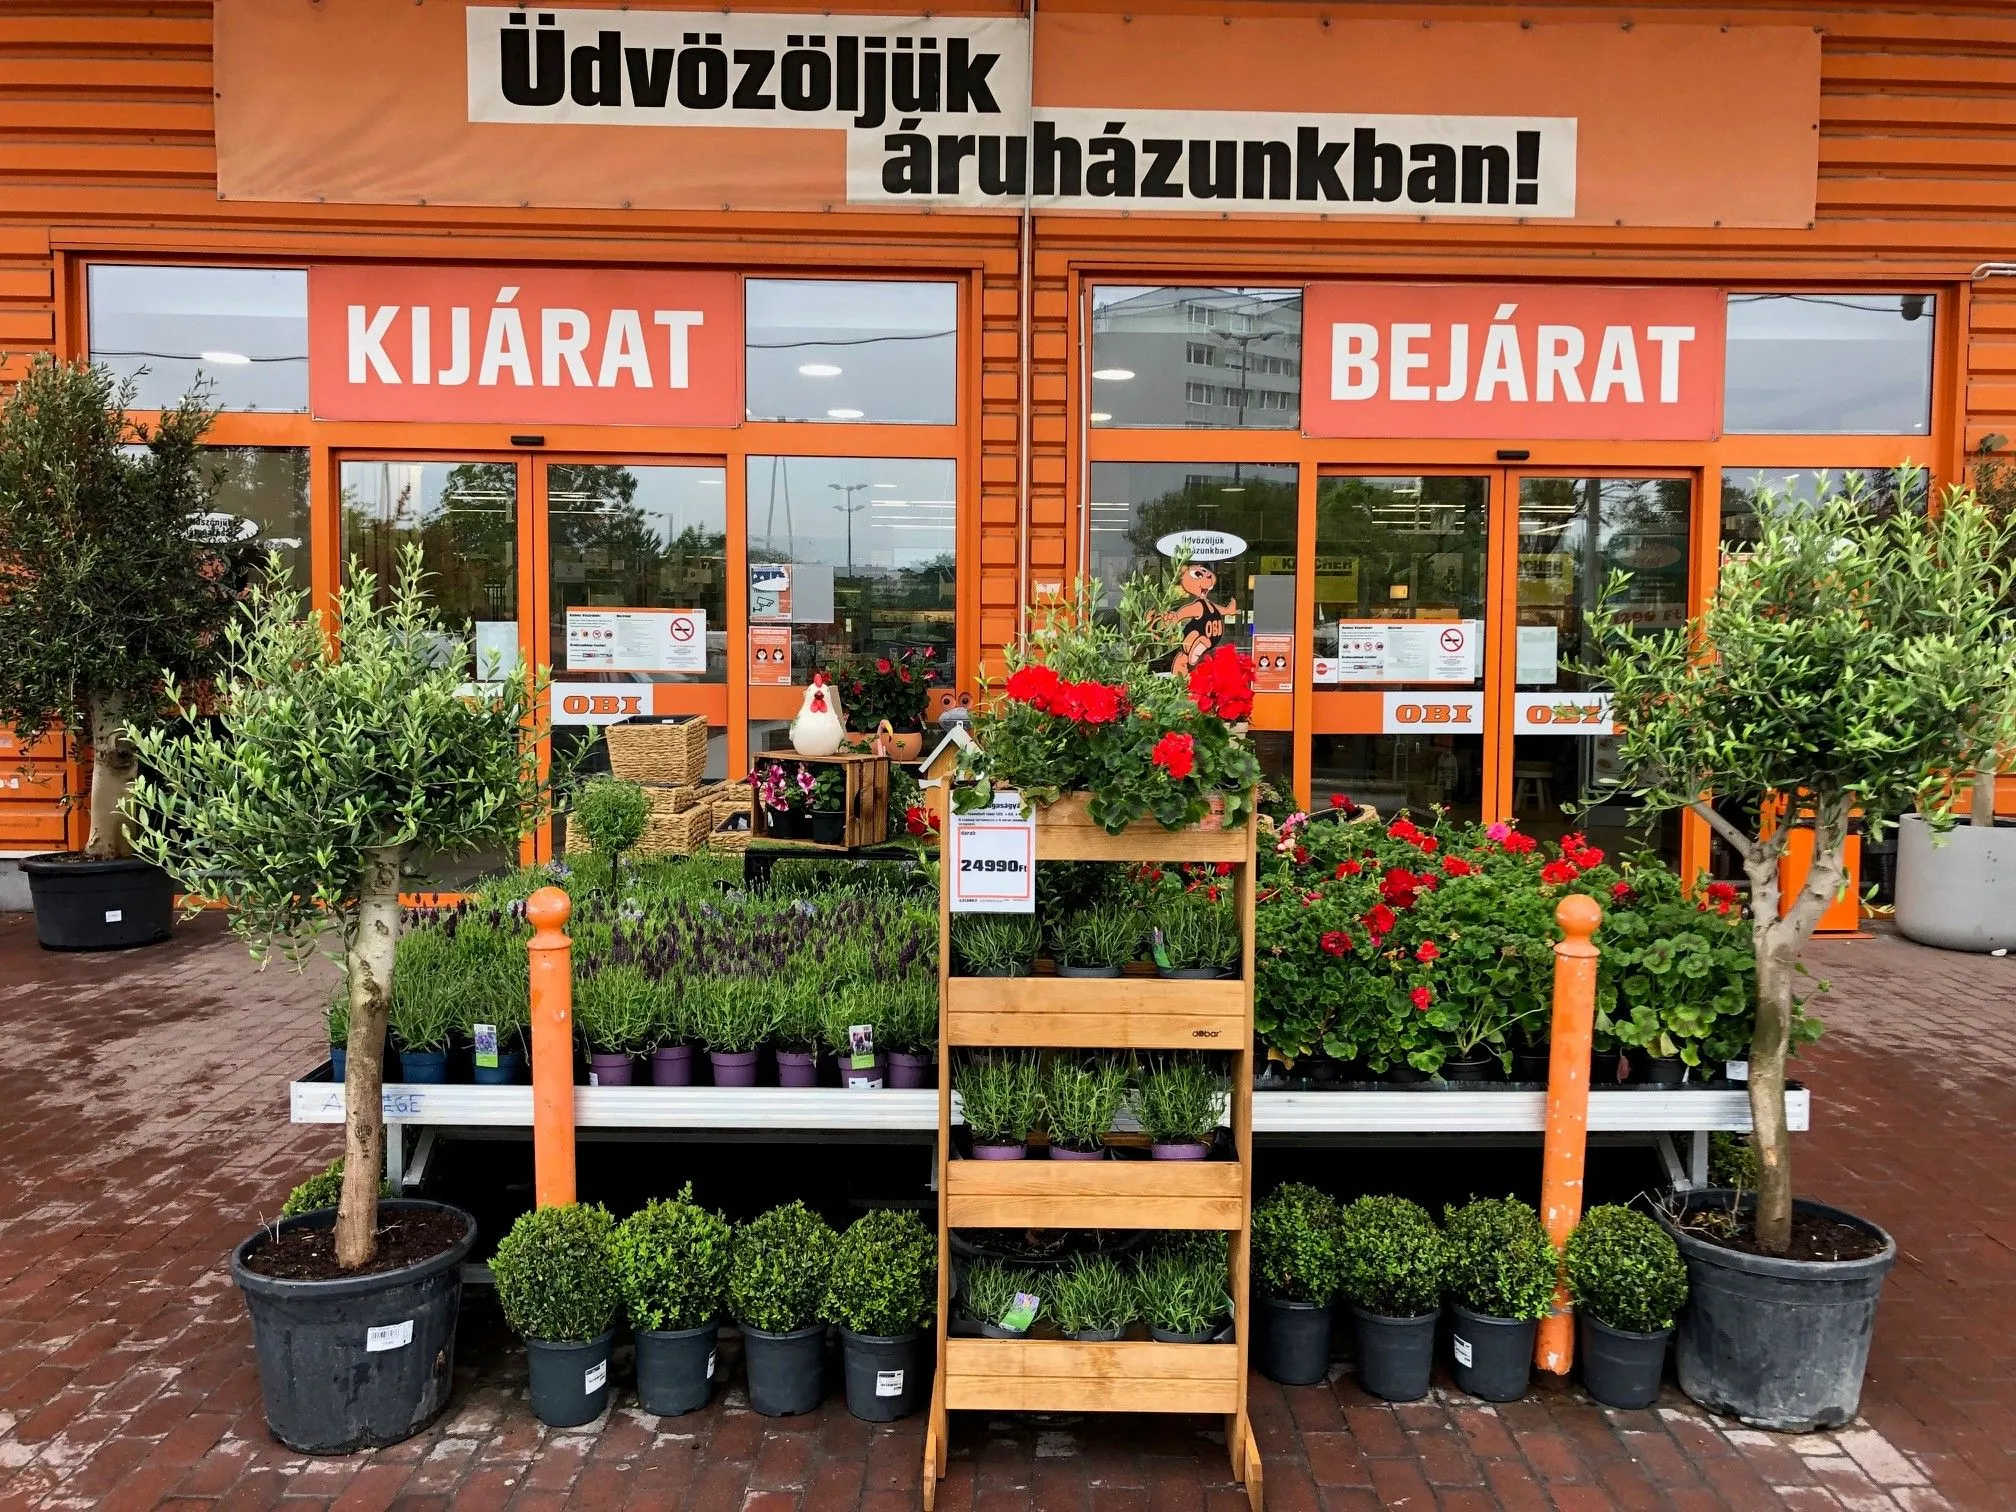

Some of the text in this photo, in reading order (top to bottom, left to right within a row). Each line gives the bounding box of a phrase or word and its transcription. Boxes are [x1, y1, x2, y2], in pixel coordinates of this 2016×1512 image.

[500, 12, 1001, 129] Üdvözöljük
[881, 117, 1541, 206] áruházunkban!
[347, 286, 704, 389] KIJÁRAT
[1330, 303, 1696, 403] BEJÁRAT
[1205, 620, 1223, 638] OBI
[563, 695, 642, 715] OBI
[1395, 704, 1473, 724] OBI
